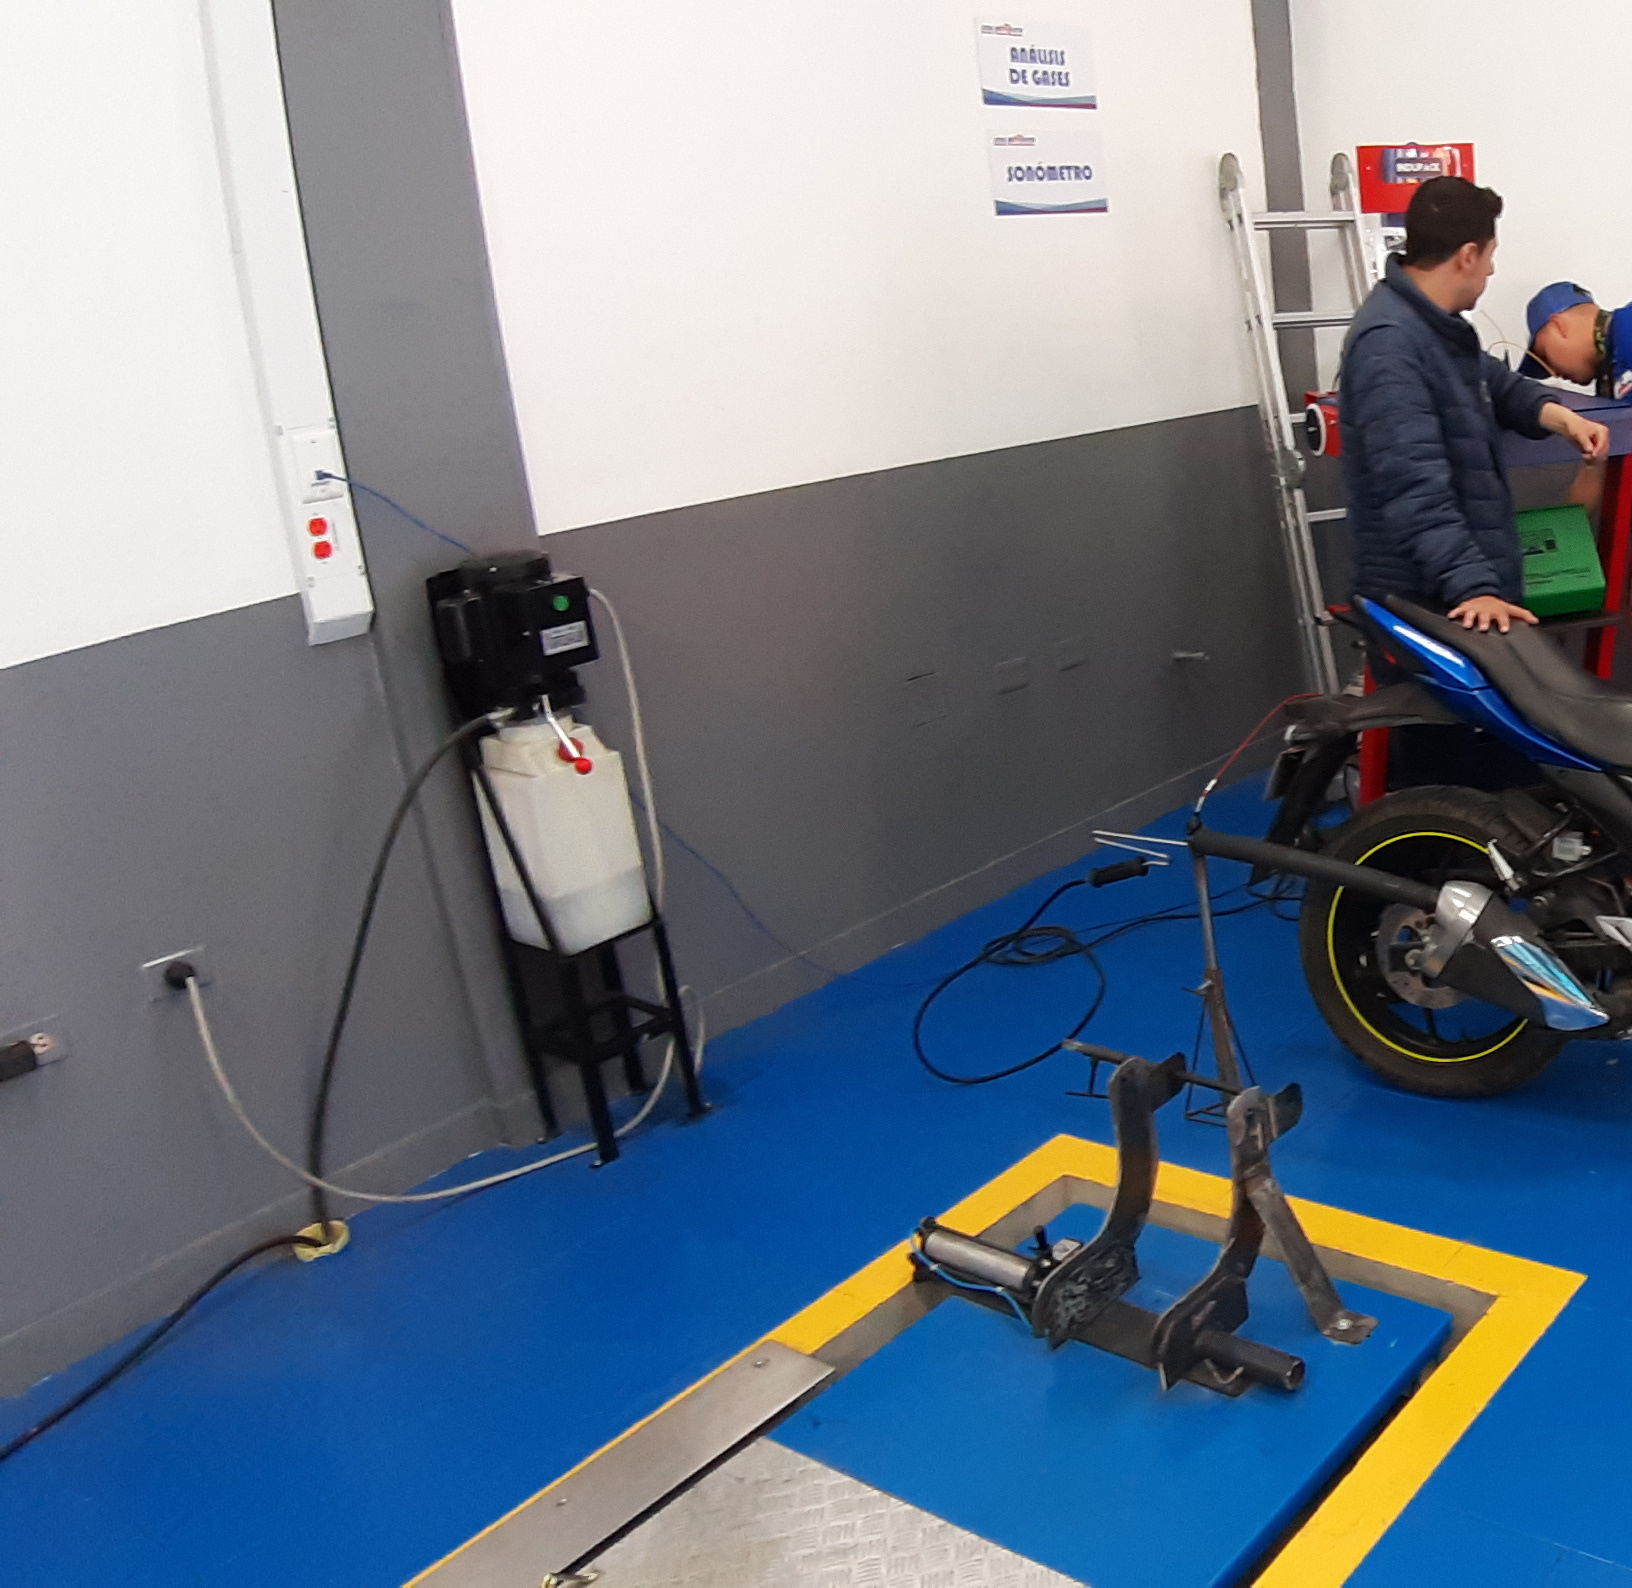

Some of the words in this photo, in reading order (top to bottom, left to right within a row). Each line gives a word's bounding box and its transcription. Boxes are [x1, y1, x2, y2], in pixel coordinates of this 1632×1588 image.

[1009, 44, 1066, 66] ANÁLISIS
[1009, 68, 1029, 85] DE
[1031, 70, 1070, 87] GASES
[1006, 162, 1093, 182] SONÓMETRO
